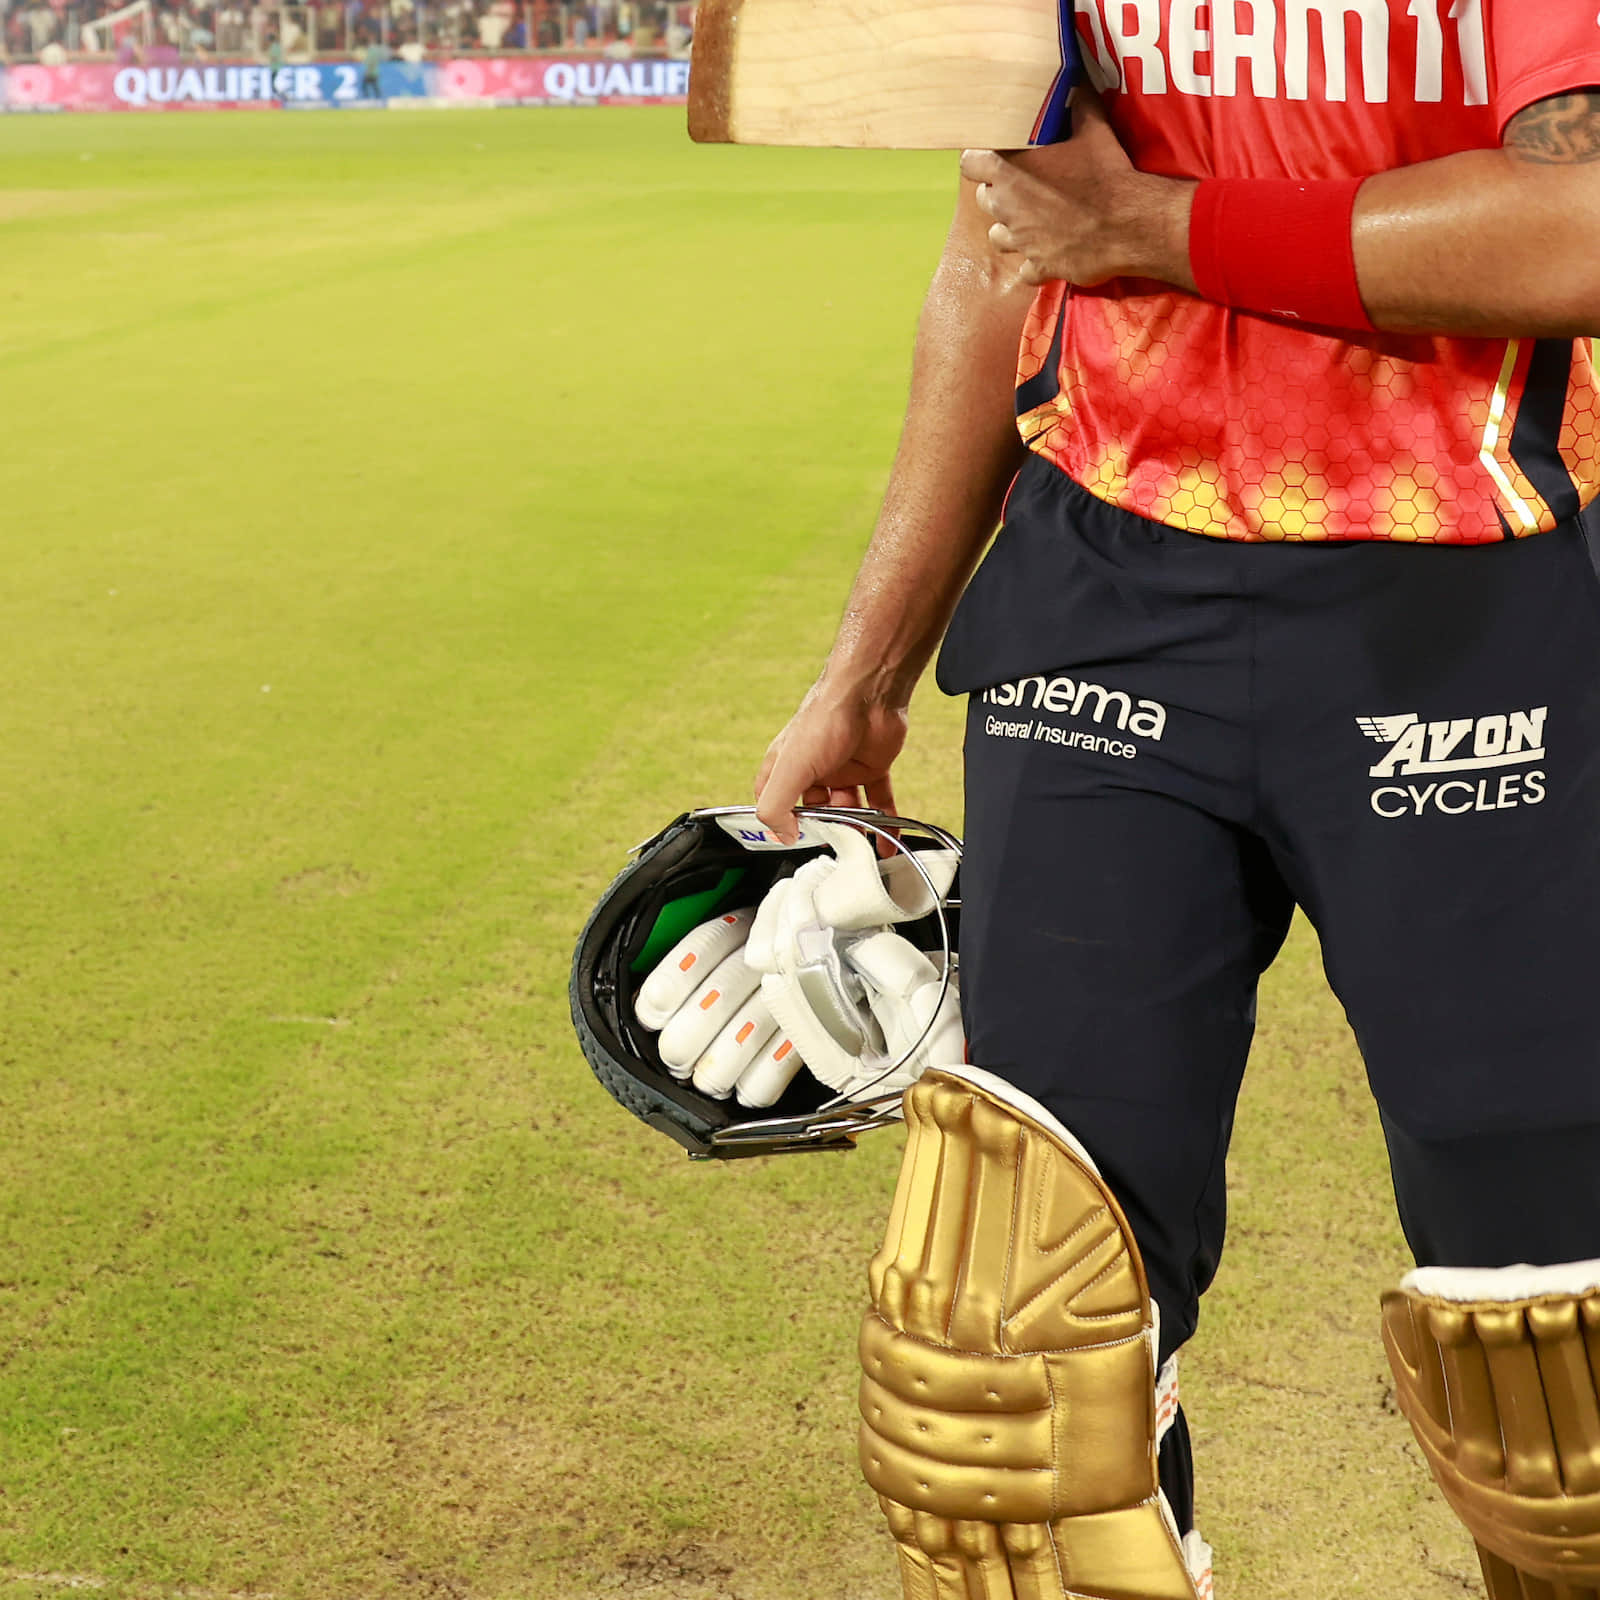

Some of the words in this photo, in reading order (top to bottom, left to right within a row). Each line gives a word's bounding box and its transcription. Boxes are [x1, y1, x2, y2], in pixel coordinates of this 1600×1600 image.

[113, 67, 321, 105] QUALIFIER
[334, 66, 359, 100] 2
[543, 62, 690, 99] QUALIF
[985, 715, 1034, 739] General
[1034, 720, 1137, 759] Insurance
[1362, 706, 1548, 777] AVON
[1370, 771, 1546, 818] CYCLES
